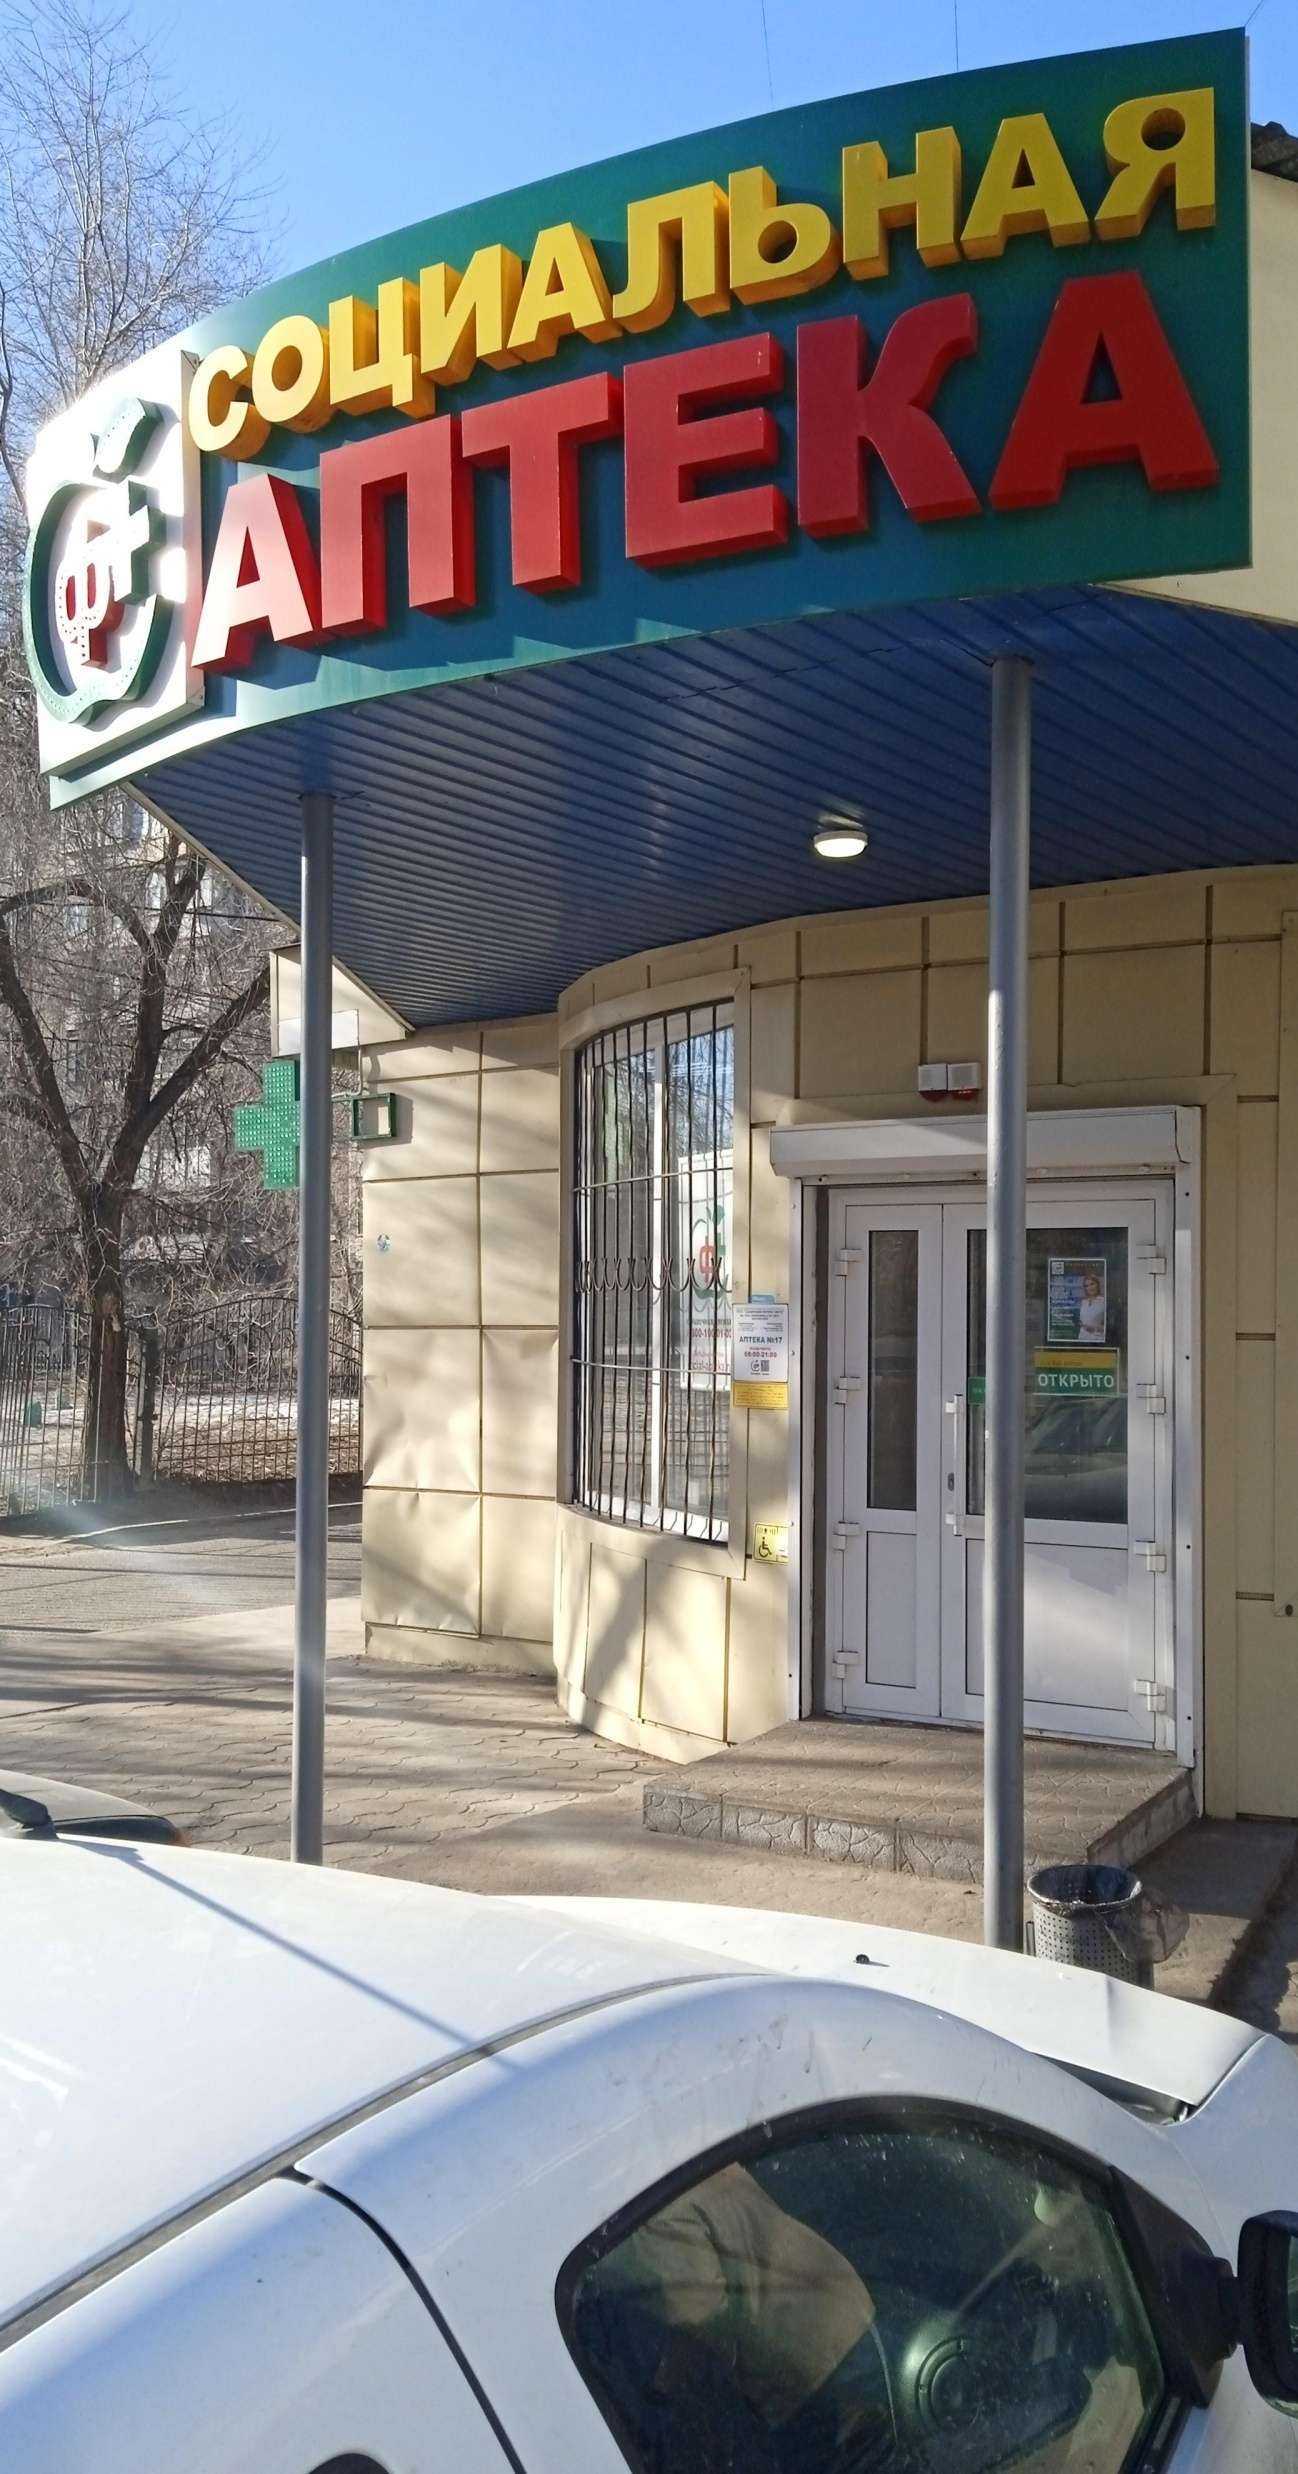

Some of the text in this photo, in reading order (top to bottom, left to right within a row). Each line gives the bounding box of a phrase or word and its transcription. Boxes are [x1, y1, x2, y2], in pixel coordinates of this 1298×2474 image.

[188, 87, 1216, 458] СОЦИАЛЬНАЯ
[191, 269, 1219, 673] АПТЕКА
[739, 1335, 765, 1344] АПТЕКА
[1038, 1373, 1114, 1388] ОТКРЫТО
